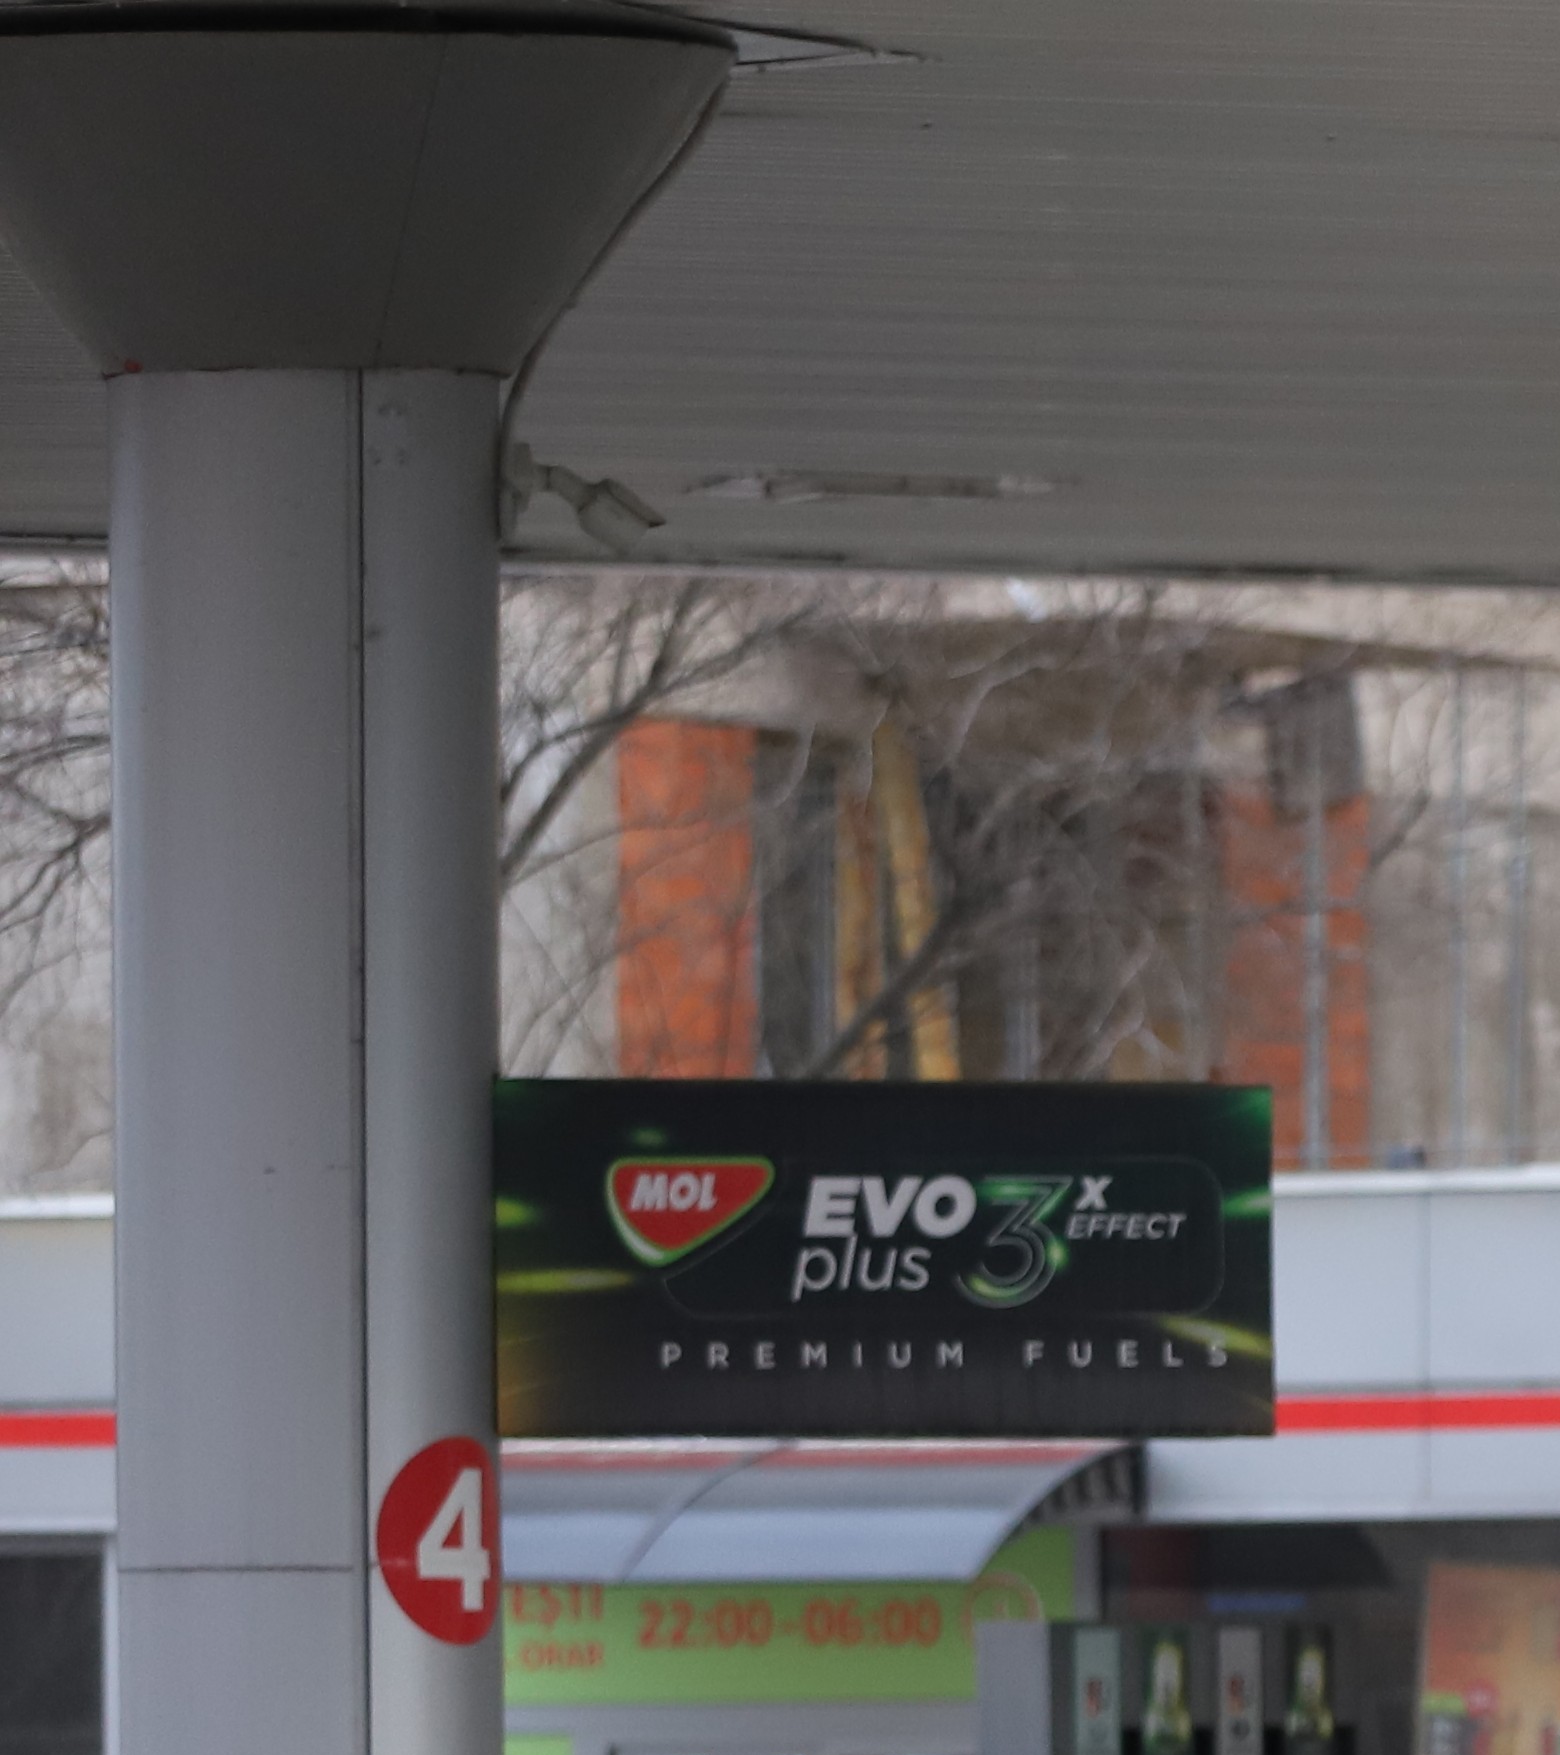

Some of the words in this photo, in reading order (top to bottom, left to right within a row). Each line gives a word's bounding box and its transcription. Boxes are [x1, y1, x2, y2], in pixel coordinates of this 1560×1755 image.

[630, 1173, 717, 1210] MOL
[803, 1176, 976, 1236] EVO
[955, 1176, 1072, 1308] 3
[1067, 1214, 1186, 1239] EFFECT
[792, 1237, 931, 1302] plus
[661, 1343, 964, 1368] PREMIUM
[1024, 1342, 1228, 1367] FUELS
[418, 1467, 490, 1610] 4
